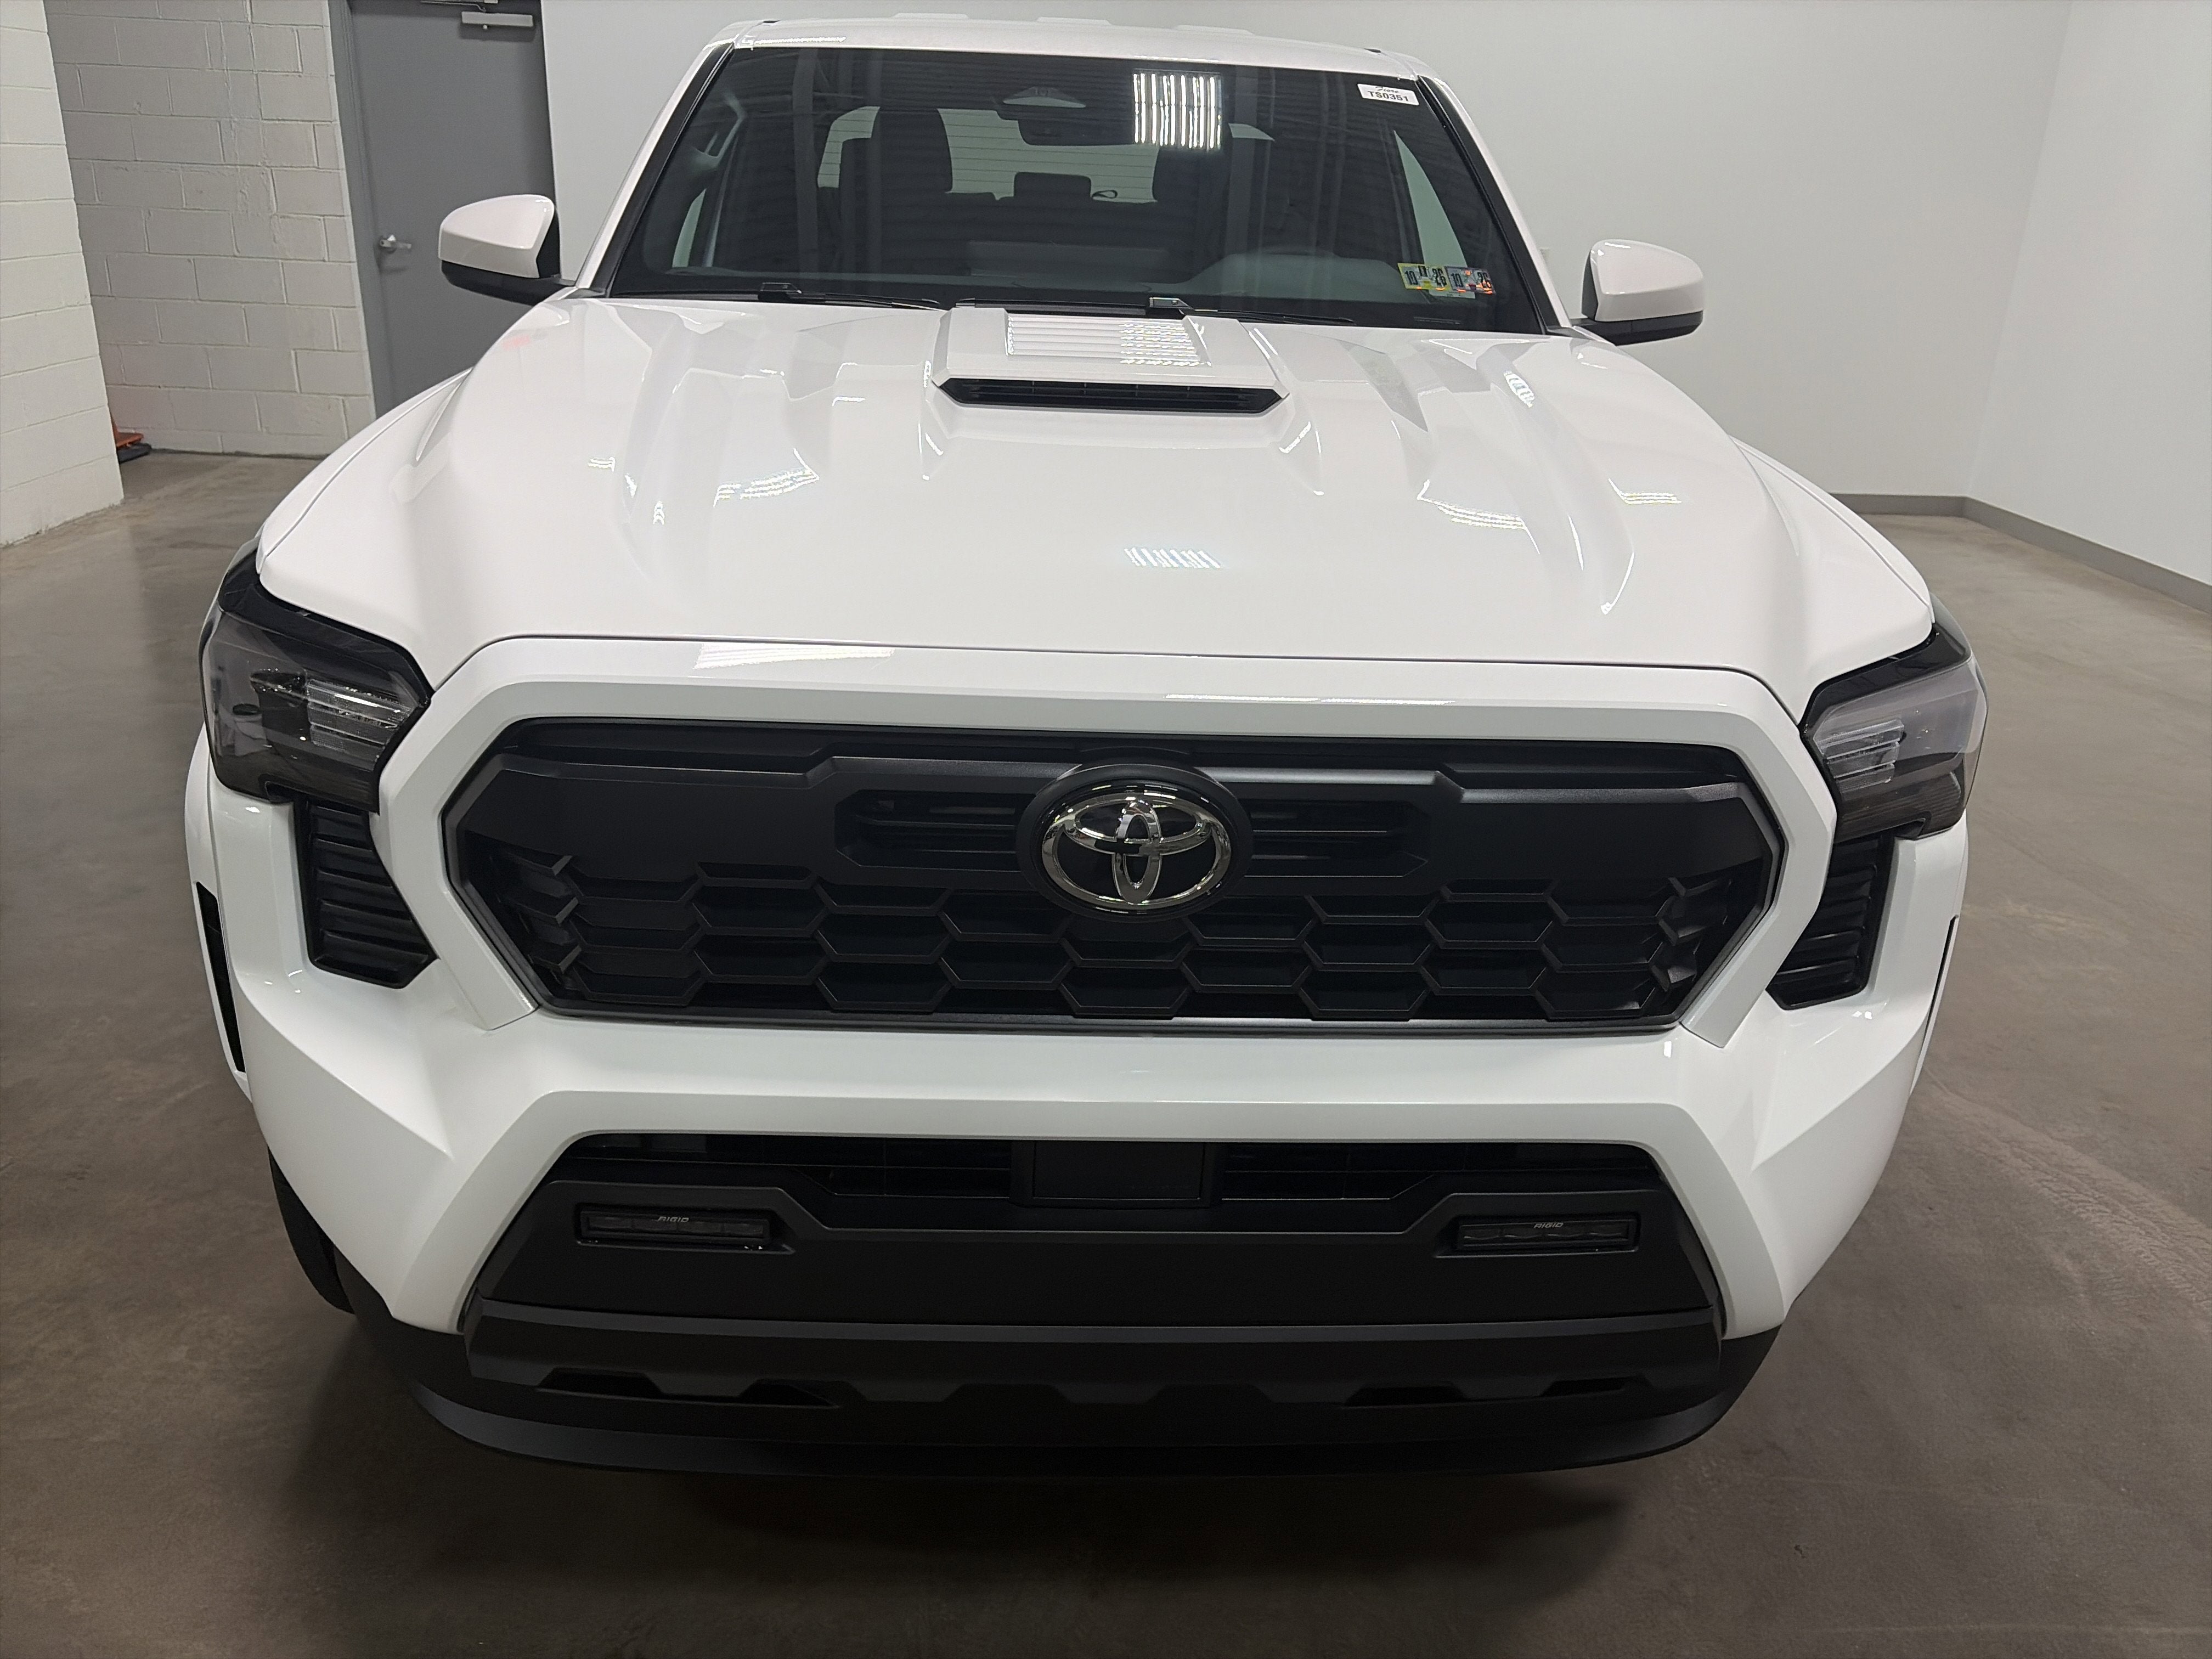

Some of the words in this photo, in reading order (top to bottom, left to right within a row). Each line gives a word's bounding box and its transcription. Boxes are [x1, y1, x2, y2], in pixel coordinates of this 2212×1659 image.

[1368, 91, 1408, 101] TS0351
[1404, 270, 1419, 285] 10
[1432, 268, 1447, 287] 26
[1451, 273, 1464, 287] 10
